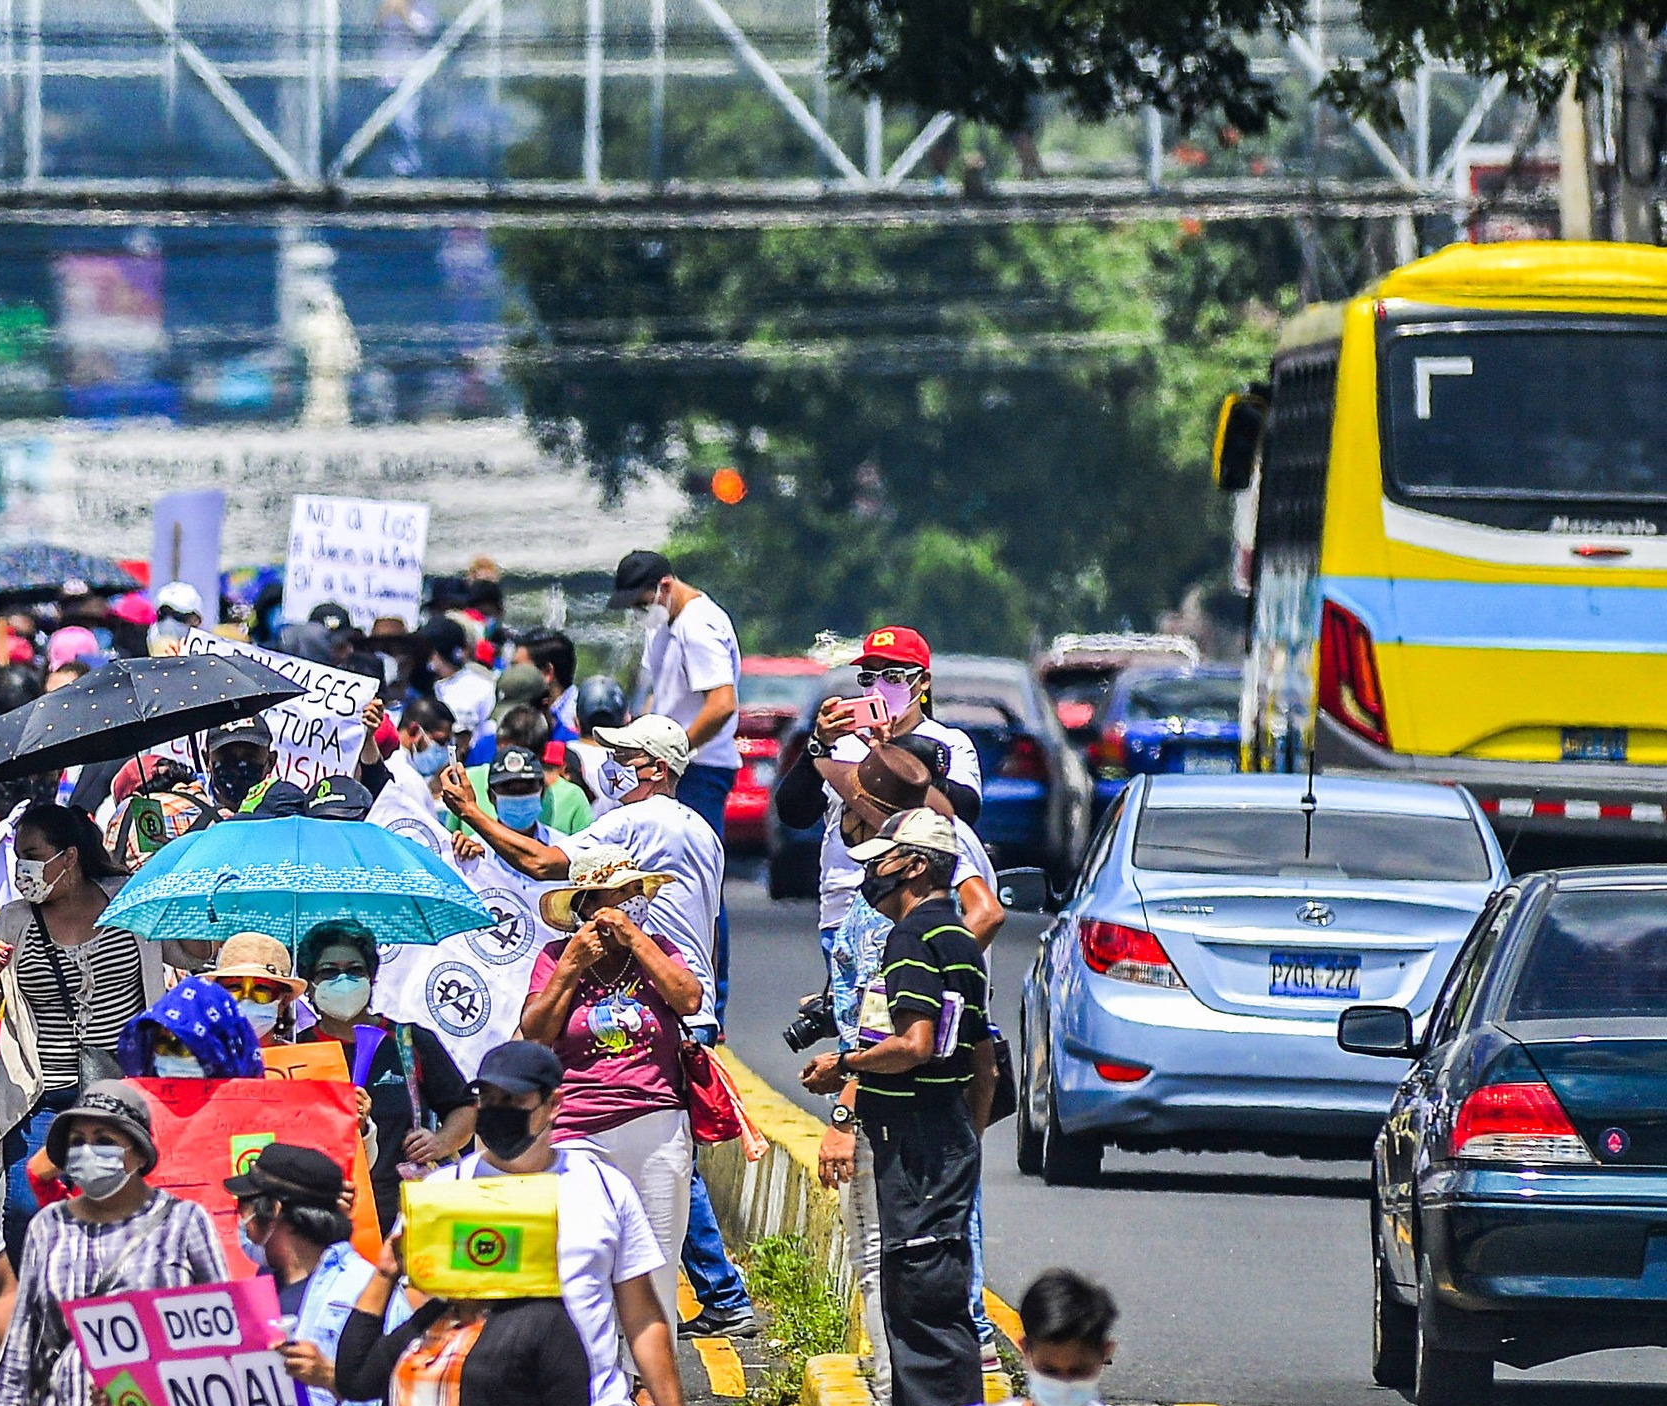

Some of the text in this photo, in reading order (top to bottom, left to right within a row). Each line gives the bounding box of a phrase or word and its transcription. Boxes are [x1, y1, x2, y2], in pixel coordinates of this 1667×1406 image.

[271, 707, 341, 762] TURA
[83, 1305, 234, 1357] YO DIGO
